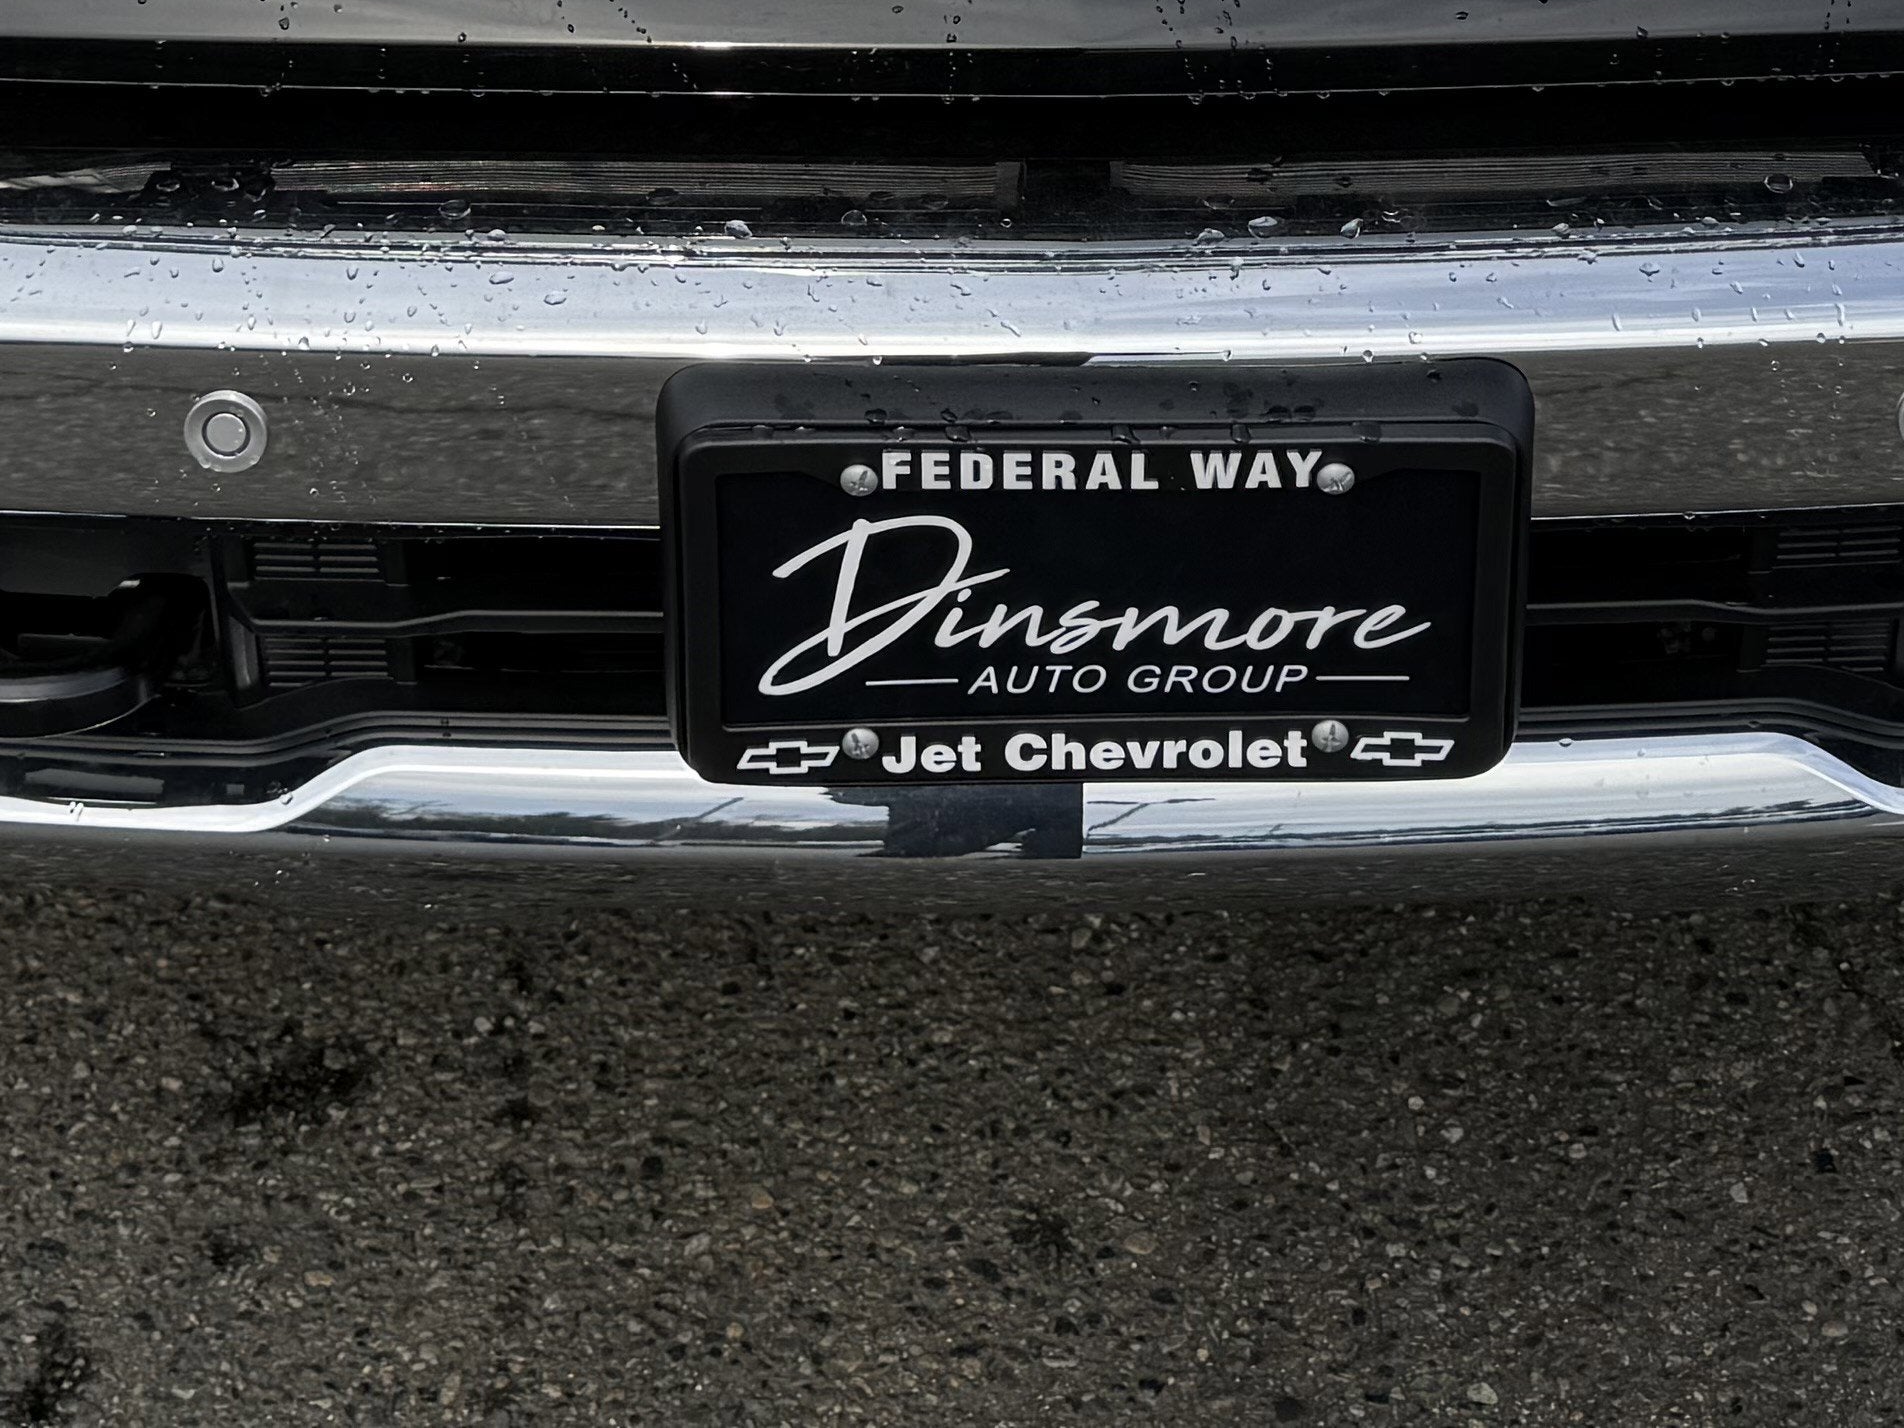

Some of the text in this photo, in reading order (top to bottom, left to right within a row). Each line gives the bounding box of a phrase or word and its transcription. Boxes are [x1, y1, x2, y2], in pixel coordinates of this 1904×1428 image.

[882, 451, 1323, 490] FEDERAL WAY
[759, 515, 1432, 696] Dinsmore
[968, 664, 1309, 695] AUTO GROUP
[882, 730, 1308, 774] Jet Chevrolet
